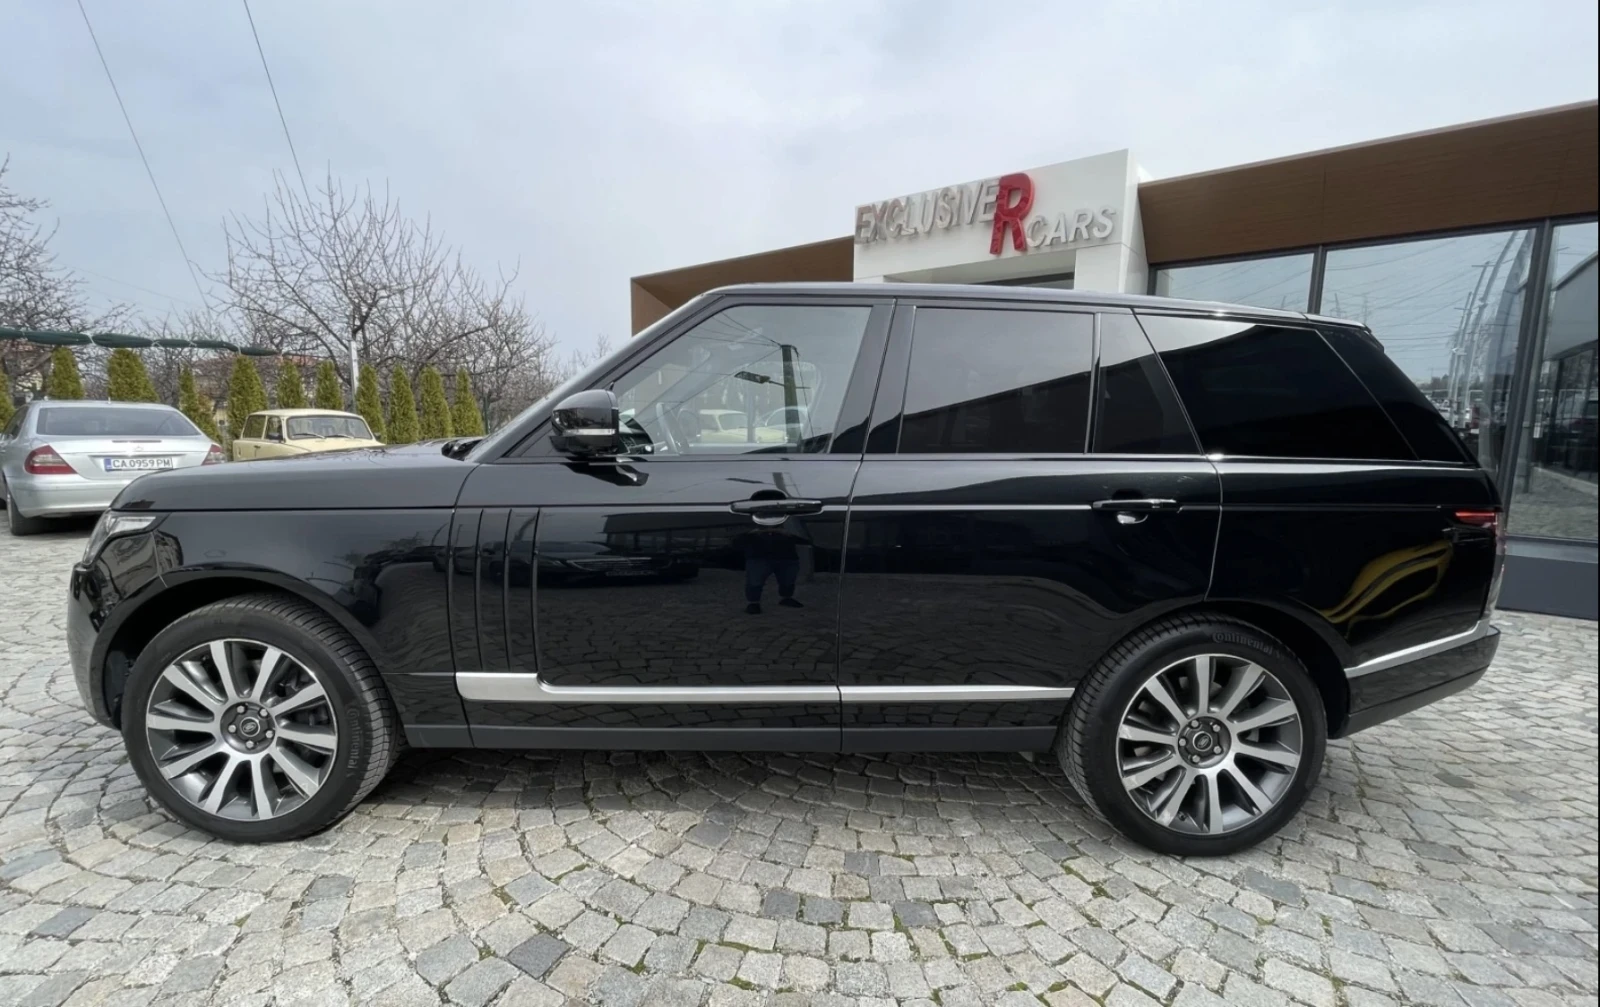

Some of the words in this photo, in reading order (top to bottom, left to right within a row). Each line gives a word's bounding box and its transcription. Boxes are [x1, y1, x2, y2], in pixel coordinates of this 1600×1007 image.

[855, 177, 1000, 245] EXCLUSIVE
[989, 172, 1035, 256] R
[1026, 205, 1119, 248] CARS
[112, 459, 127, 468] CA
[129, 459, 155, 468] 0959
